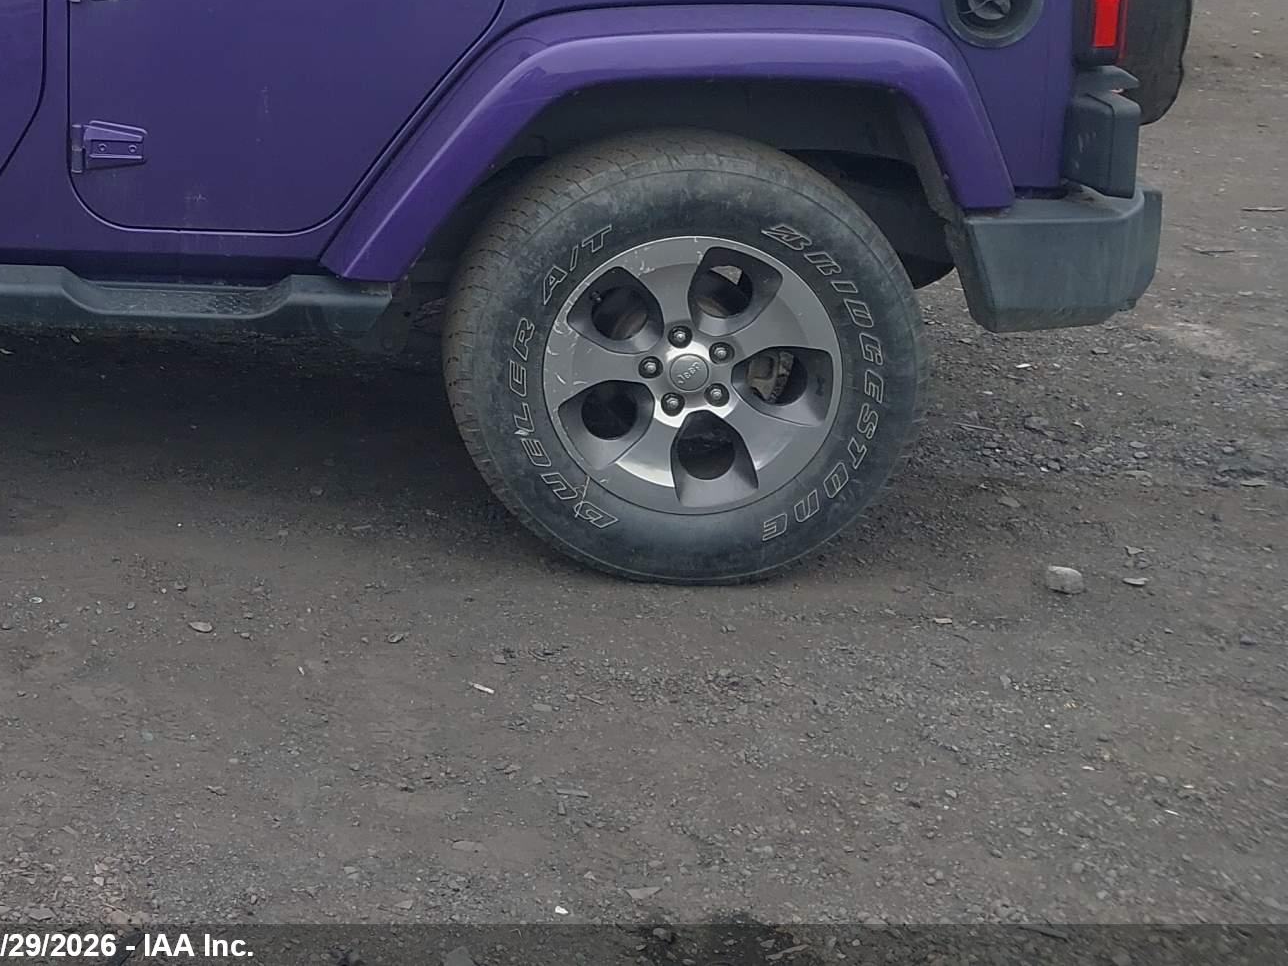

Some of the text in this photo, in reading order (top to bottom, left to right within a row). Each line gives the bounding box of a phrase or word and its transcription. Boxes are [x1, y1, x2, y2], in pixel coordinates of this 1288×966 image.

[508, 223, 619, 529] DUELER A/T
[760, 224, 884, 542] BRIDGESTONE
